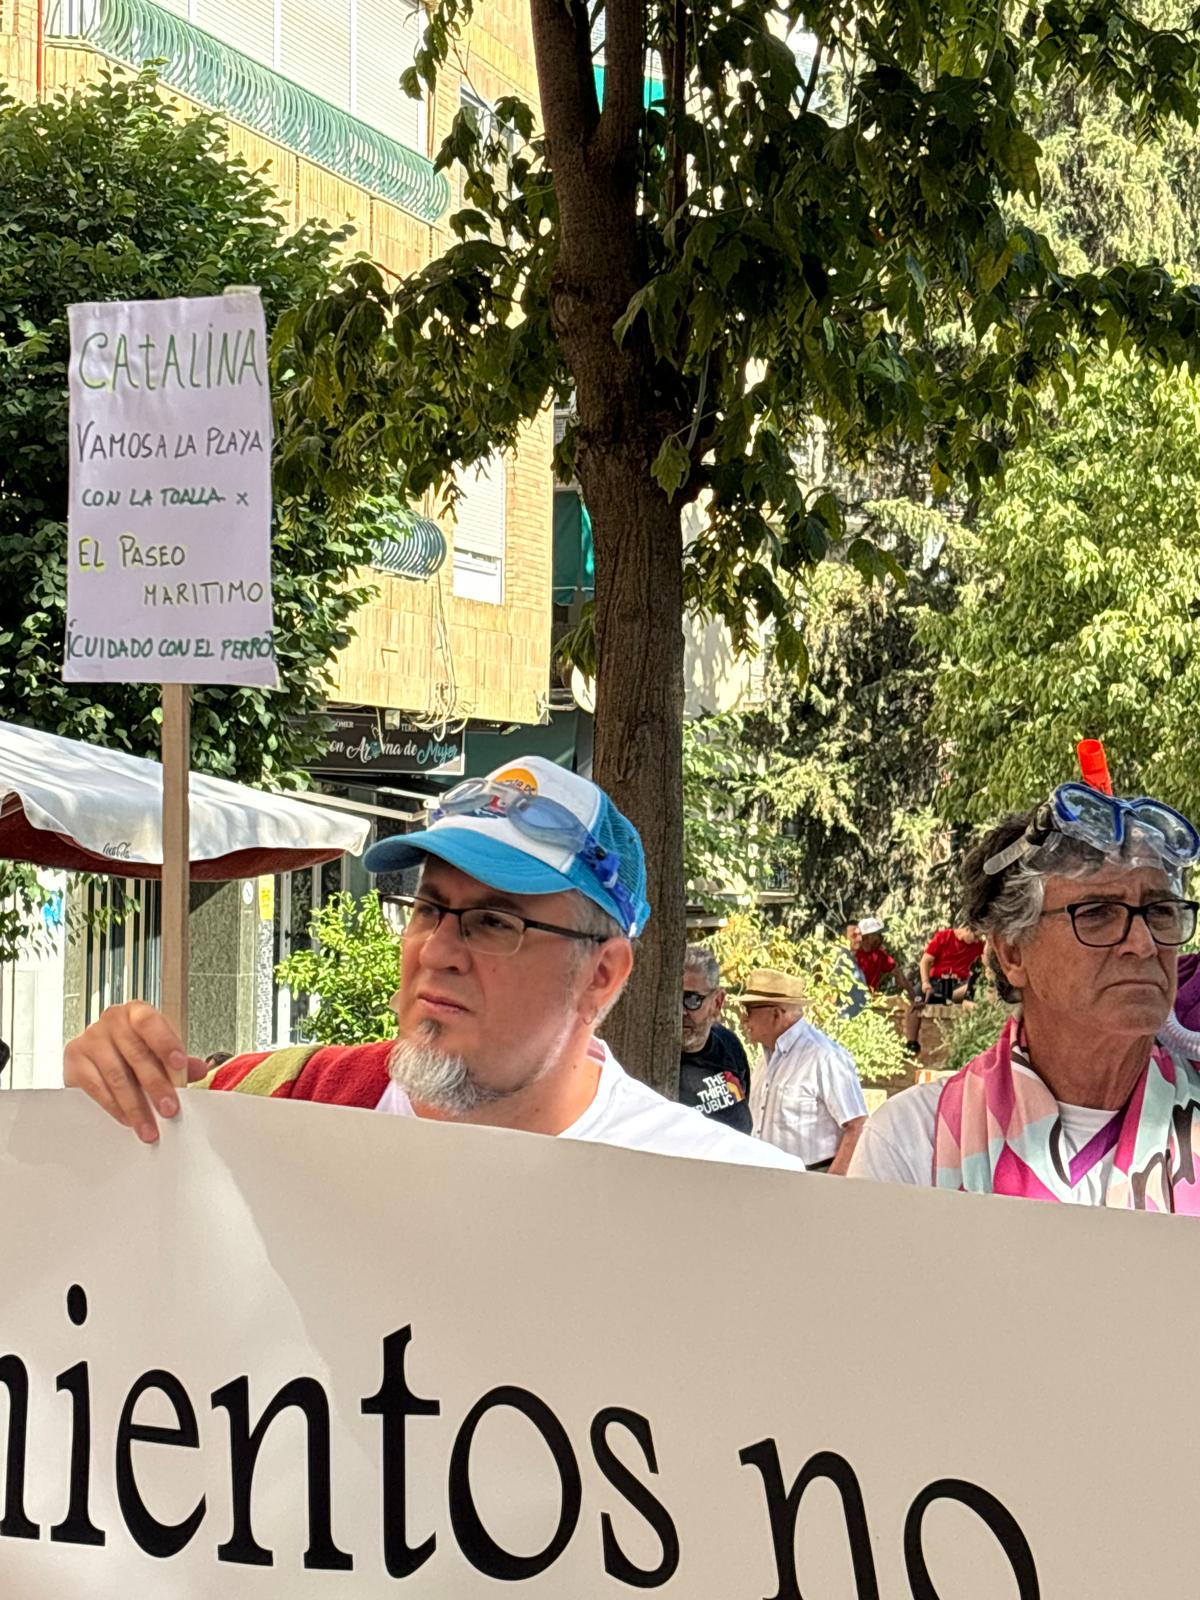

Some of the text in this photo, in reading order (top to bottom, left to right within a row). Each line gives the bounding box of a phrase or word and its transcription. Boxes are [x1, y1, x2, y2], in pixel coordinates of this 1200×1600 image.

[76, 421, 264, 462] VAMOS A LA PLAYA
[82, 488, 121, 507] CON
[129, 488, 153, 507] LA
[160, 487, 226, 507] TOALLA
[78, 535, 186, 568] EL PASEO
[143, 579, 264, 606] MARITIMO
[158, 638, 192, 657] CON
[193, 639, 214, 657] EL
[403, 740, 418, 756] de
[416, 740, 458, 765] Mujer
[702, 1071, 726, 1089] THE
[695, 1094, 735, 1114] PUBLIC
[697, 1083, 730, 1104] THIRD
[738, 1437, 1041, 1600] no
